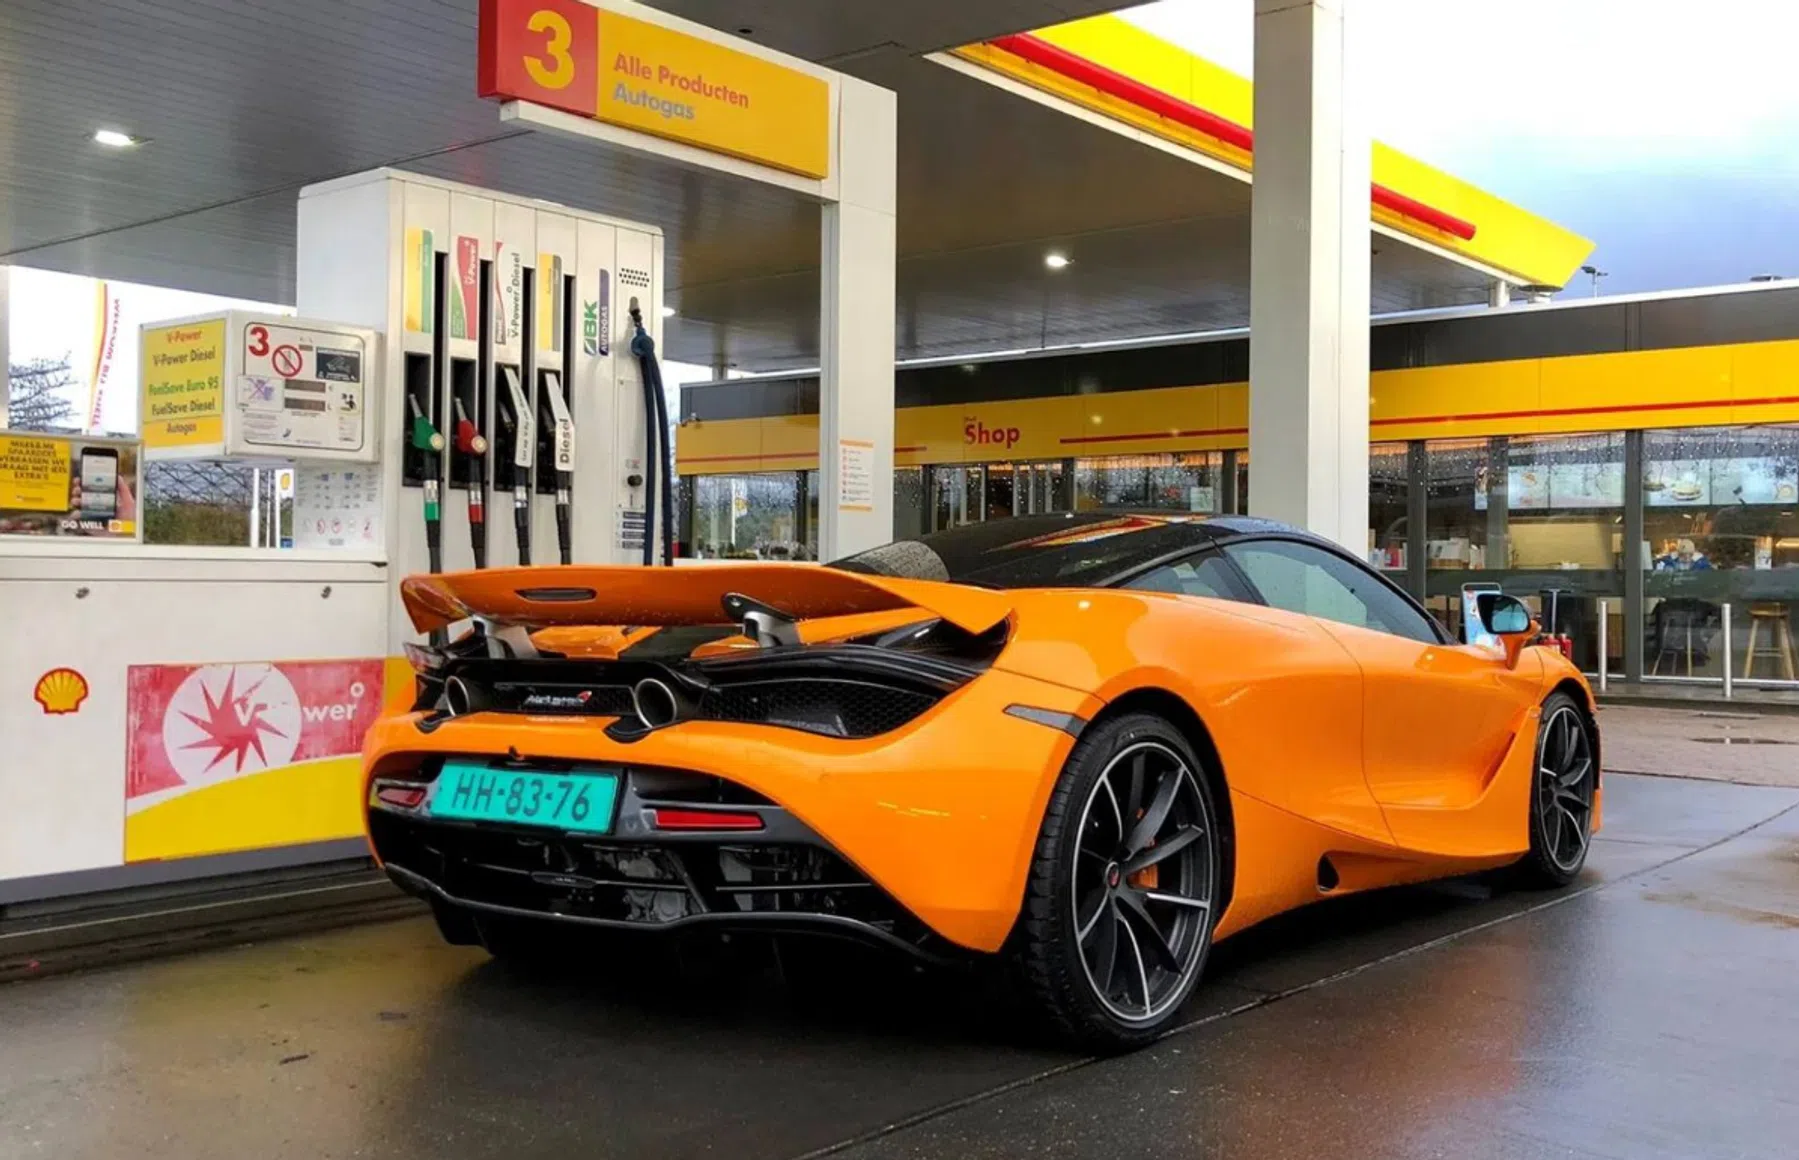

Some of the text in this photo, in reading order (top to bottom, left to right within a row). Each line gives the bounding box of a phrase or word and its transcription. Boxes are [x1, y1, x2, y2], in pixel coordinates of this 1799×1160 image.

[523, 9, 575, 90] 3
[613, 52, 749, 109] Alle Producten
[613, 82, 695, 120] Autogas
[511, 252, 520, 286] Diesel
[166, 330, 202, 343] V-Power
[248, 326, 270, 357] 3
[153, 345, 216, 366] V-Power Diesel
[186, 379, 206, 392] Euro
[208, 376, 219, 389] 95
[152, 397, 216, 416] FuelSave Diesel
[167, 423, 197, 436] Autogas
[559, 418, 571, 464] Diesel
[964, 421, 1020, 450] Shop
[61, 520, 105, 530] GO WELL
[451, 772, 592, 822] HH-83-76
